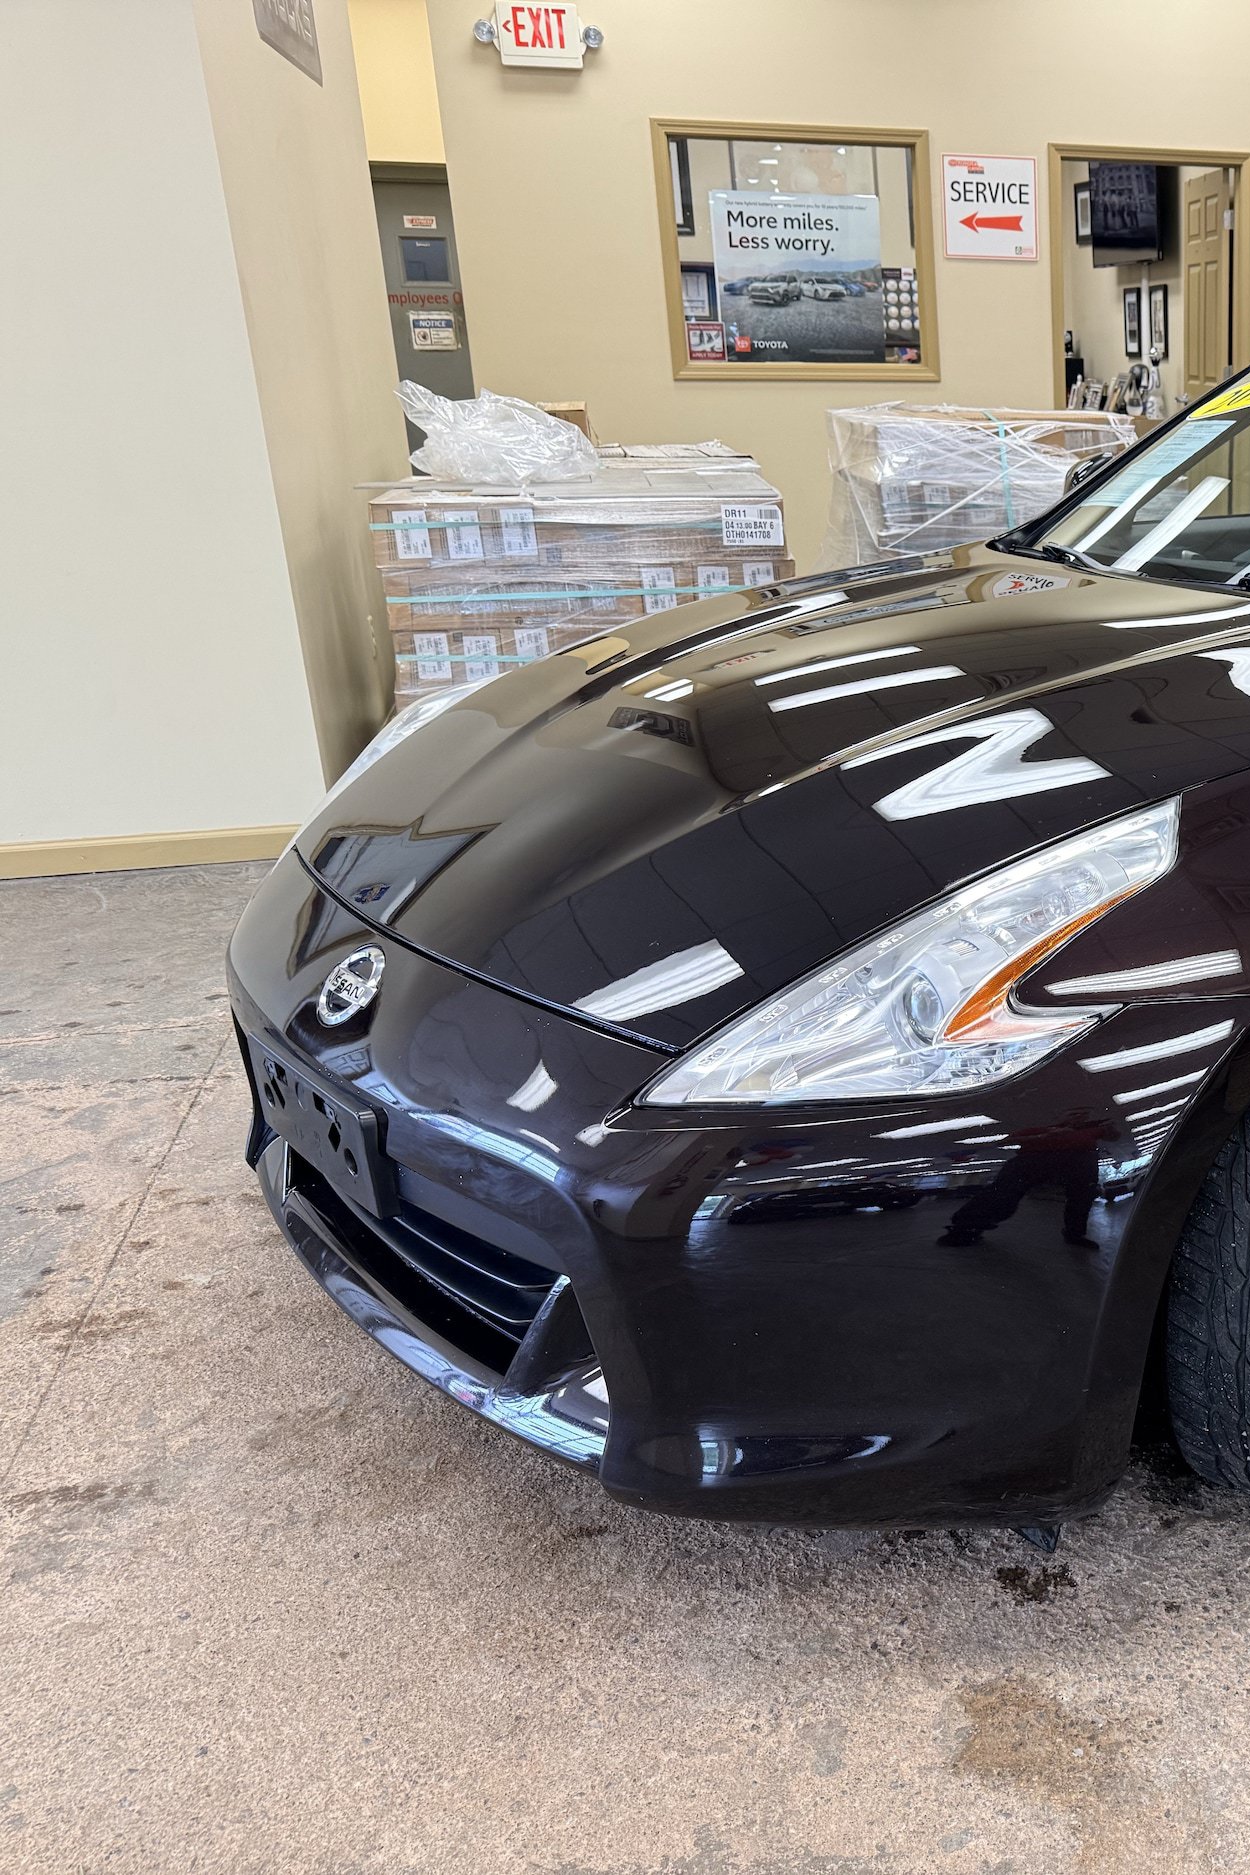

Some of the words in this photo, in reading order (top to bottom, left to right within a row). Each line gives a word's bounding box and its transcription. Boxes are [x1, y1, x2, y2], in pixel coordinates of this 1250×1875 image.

[511, 6, 566, 49] EXIT
[950, 180, 1030, 205] SERVICE
[727, 210, 777, 229] More
[784, 212, 839, 232] miles.
[728, 231, 770, 250] Less
[775, 237, 835, 256] worry.
[388, 291, 449, 307] mployees
[753, 340, 788, 349] TOYOTA
[724, 509, 746, 518] DR11
[725, 521, 734, 530] 04
[753, 521, 767, 530] BAY
[769, 521, 774, 530] 6
